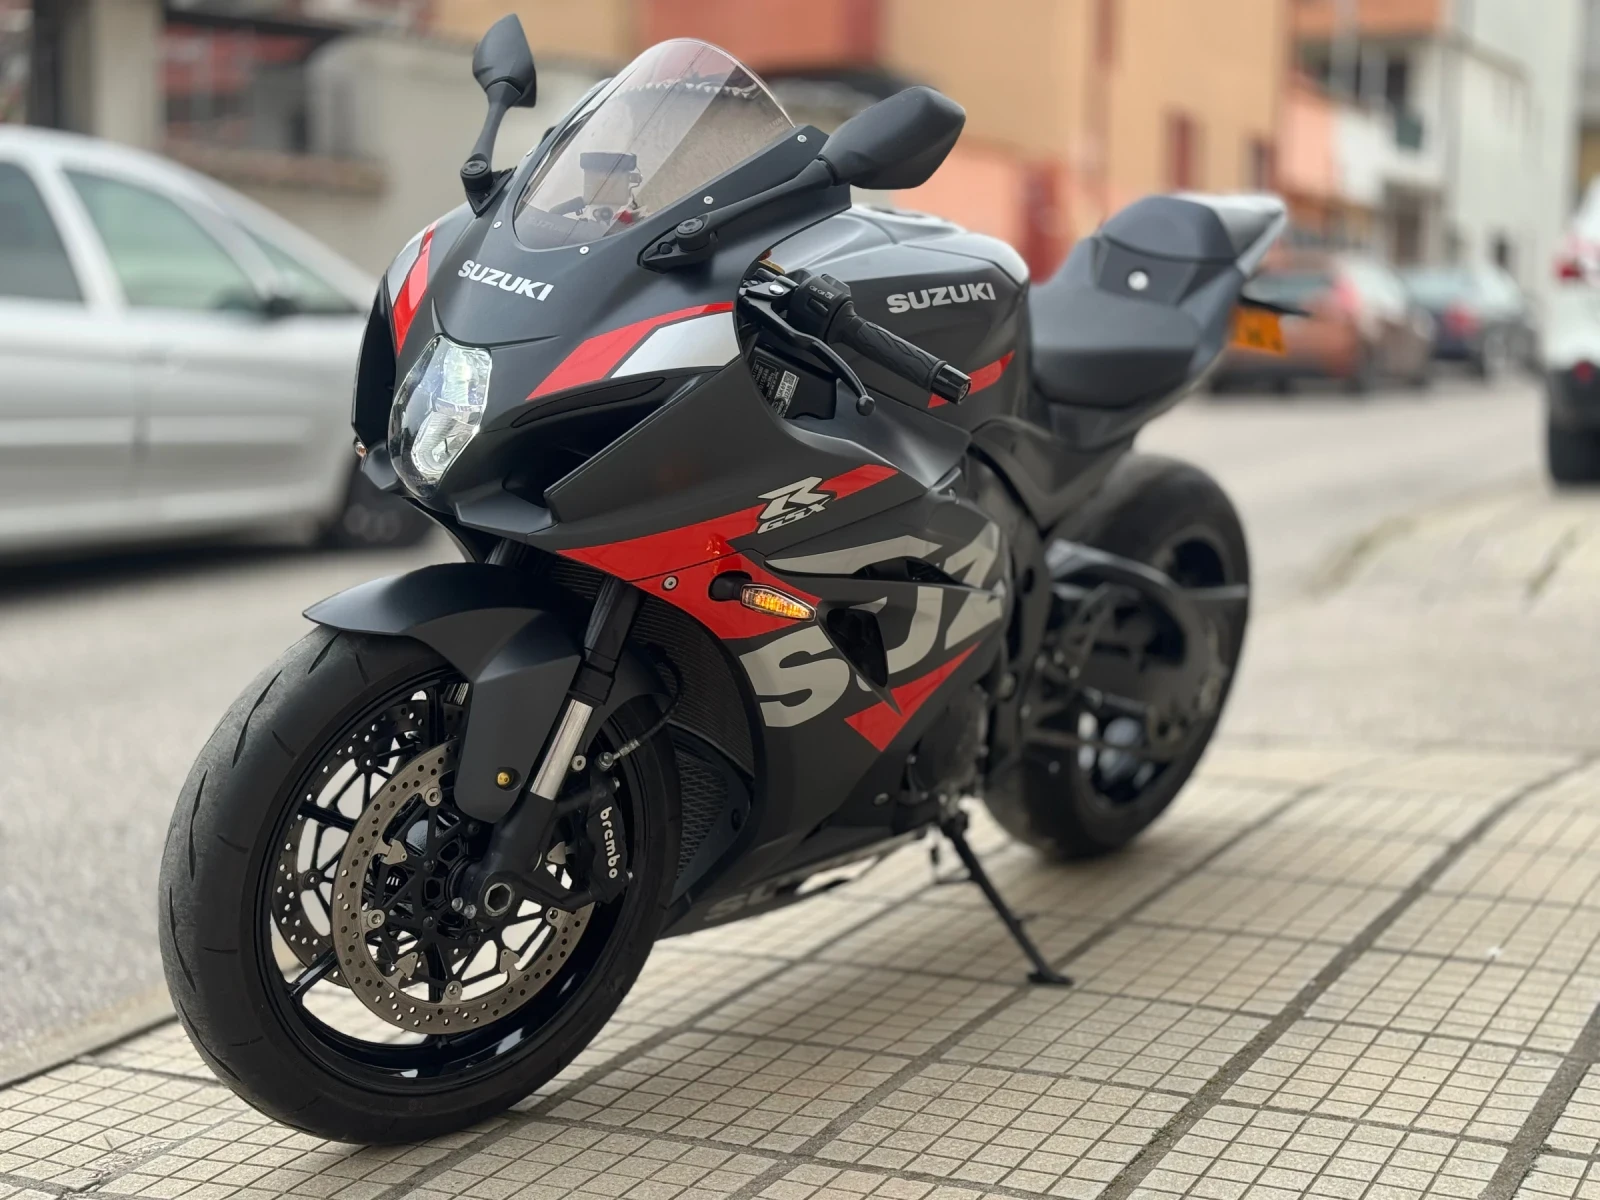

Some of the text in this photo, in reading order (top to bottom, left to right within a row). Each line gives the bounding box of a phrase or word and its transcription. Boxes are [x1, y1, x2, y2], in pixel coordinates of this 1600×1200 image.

[457, 259, 555, 302] SUZUKI
[886, 282, 998, 314] SUZUKI
[600, 806, 621, 879] brembo
